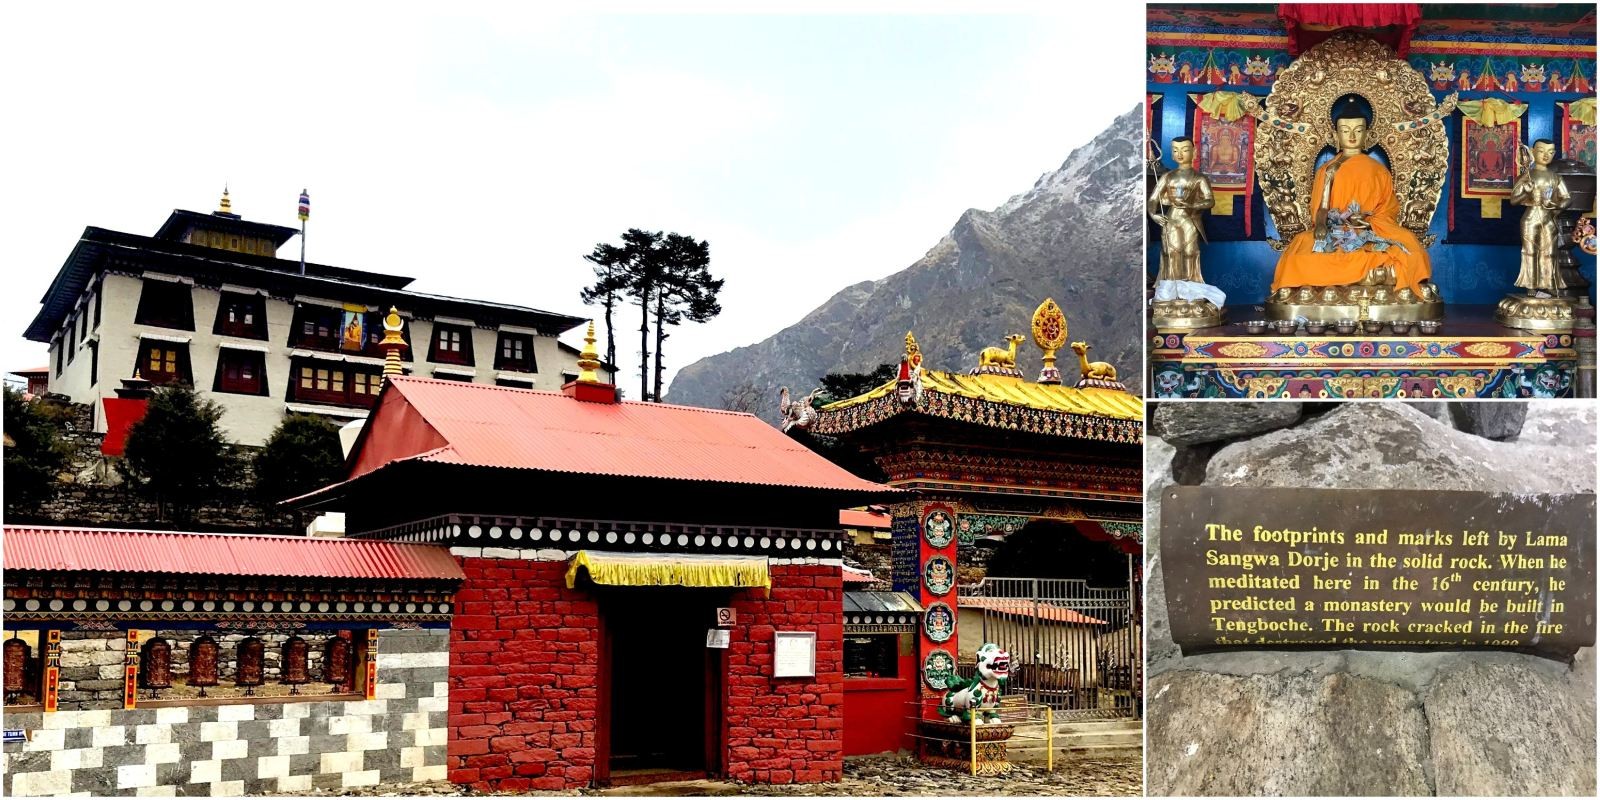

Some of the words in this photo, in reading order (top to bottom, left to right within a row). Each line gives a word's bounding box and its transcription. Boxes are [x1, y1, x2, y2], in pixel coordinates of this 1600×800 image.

[1205, 524, 1242, 541] The
[1253, 526, 1345, 547] footprints
[1355, 530, 1387, 545] and
[1399, 530, 1452, 546] marks
[1462, 531, 1489, 546] left
[1499, 531, 1517, 550] by
[1526, 532, 1568, 546] Lama
[1206, 550, 1280, 569] Sangwa
[1288, 551, 1339, 571] Dorje
[1346, 552, 1362, 568] in
[1370, 553, 1396, 568] the
[1403, 553, 1442, 569] solid
[1450, 554, 1492, 569] rock.
[1500, 555, 1544, 568] When
[1550, 555, 1567, 568] he
[1208, 574, 1300, 589] meditated
[1313, 575, 1351, 589] here
[1364, 576, 1380, 590] in
[1392, 577, 1418, 590] the
[1473, 579, 1539, 595] century,
[1550, 577, 1566, 591] he
[1210, 596, 1296, 613] predicted
[1305, 601, 1314, 611] a
[1323, 601, 1412, 615] monastery
[1421, 599, 1471, 613] would
[1480, 599, 1498, 613] be
[1507, 600, 1543, 612] built
[1551, 600, 1564, 612] in
[1212, 618, 1312, 634] Tengboche.
[1322, 619, 1354, 632] The
[1363, 619, 1399, 632] rock
[1408, 620, 1472, 633] cracked
[1480, 621, 1495, 633] in
[1504, 621, 1528, 633] the
[1536, 621, 1563, 633] fire
